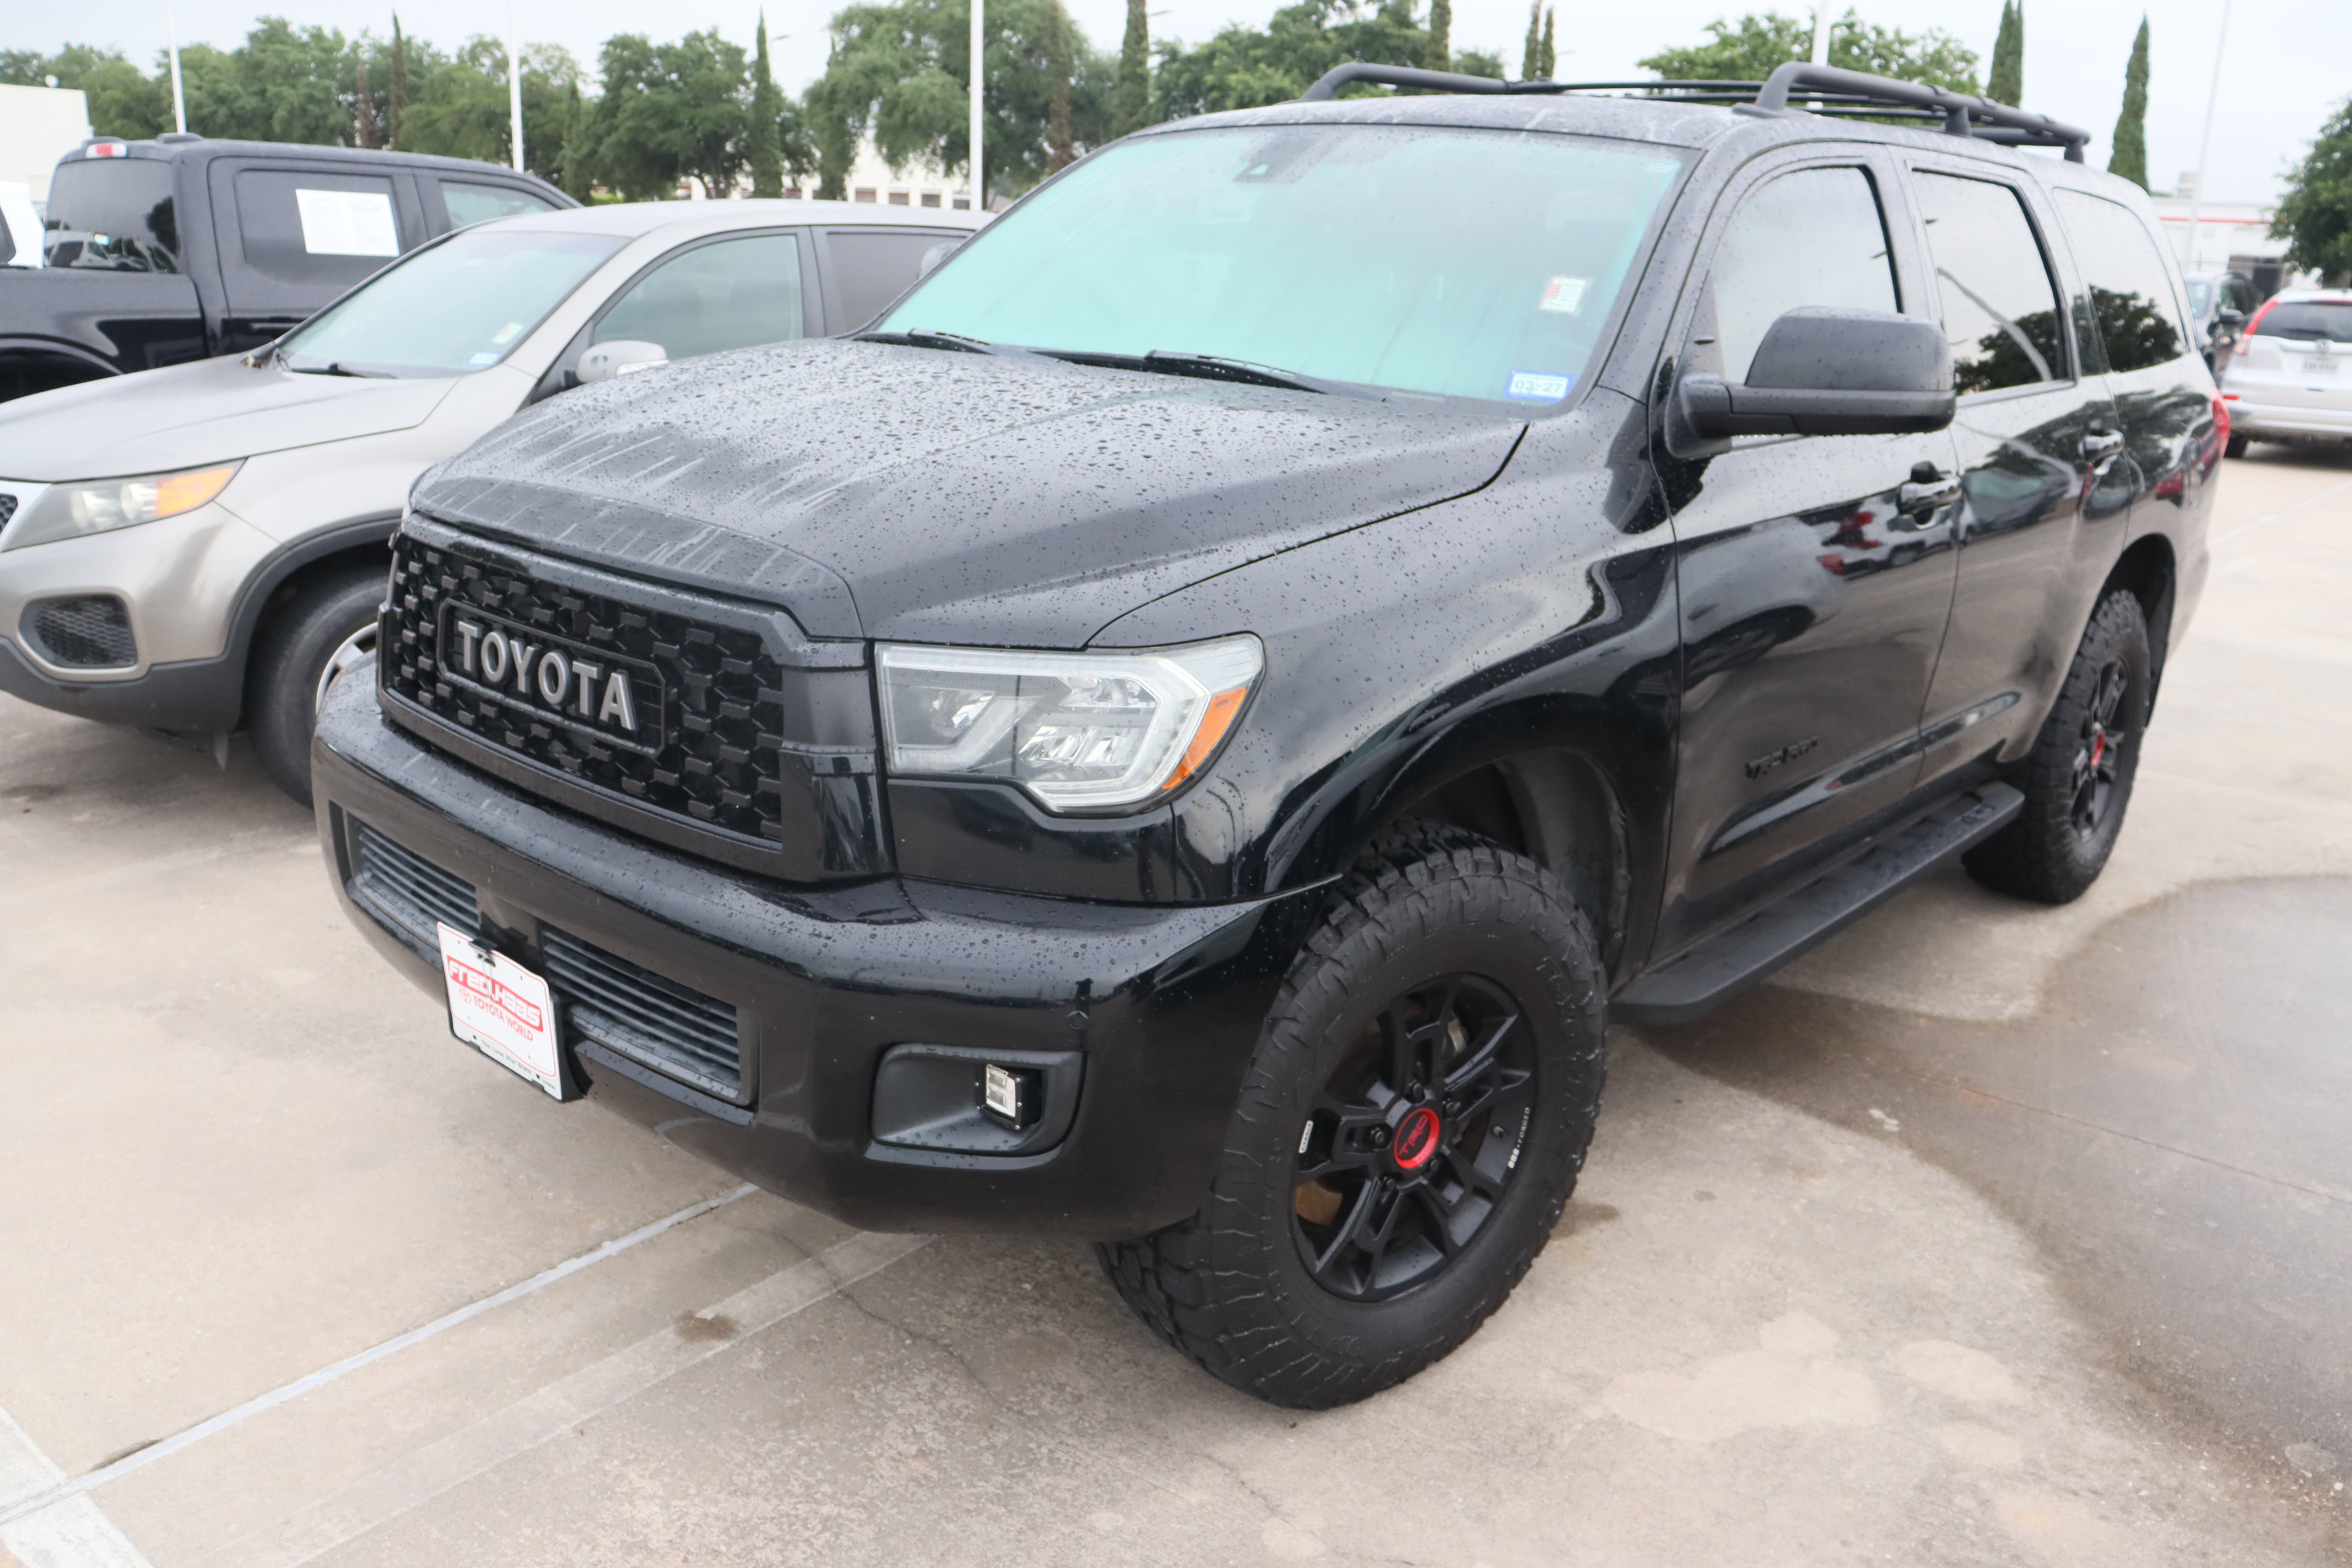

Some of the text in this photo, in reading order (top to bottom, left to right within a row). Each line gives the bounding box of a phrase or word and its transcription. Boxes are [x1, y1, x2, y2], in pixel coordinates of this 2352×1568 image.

[458, 620, 638, 731] TOYOTA
[473, 997, 533, 1041] TOYOTA WORLD
[1398, 1114, 1428, 1155] TRD
